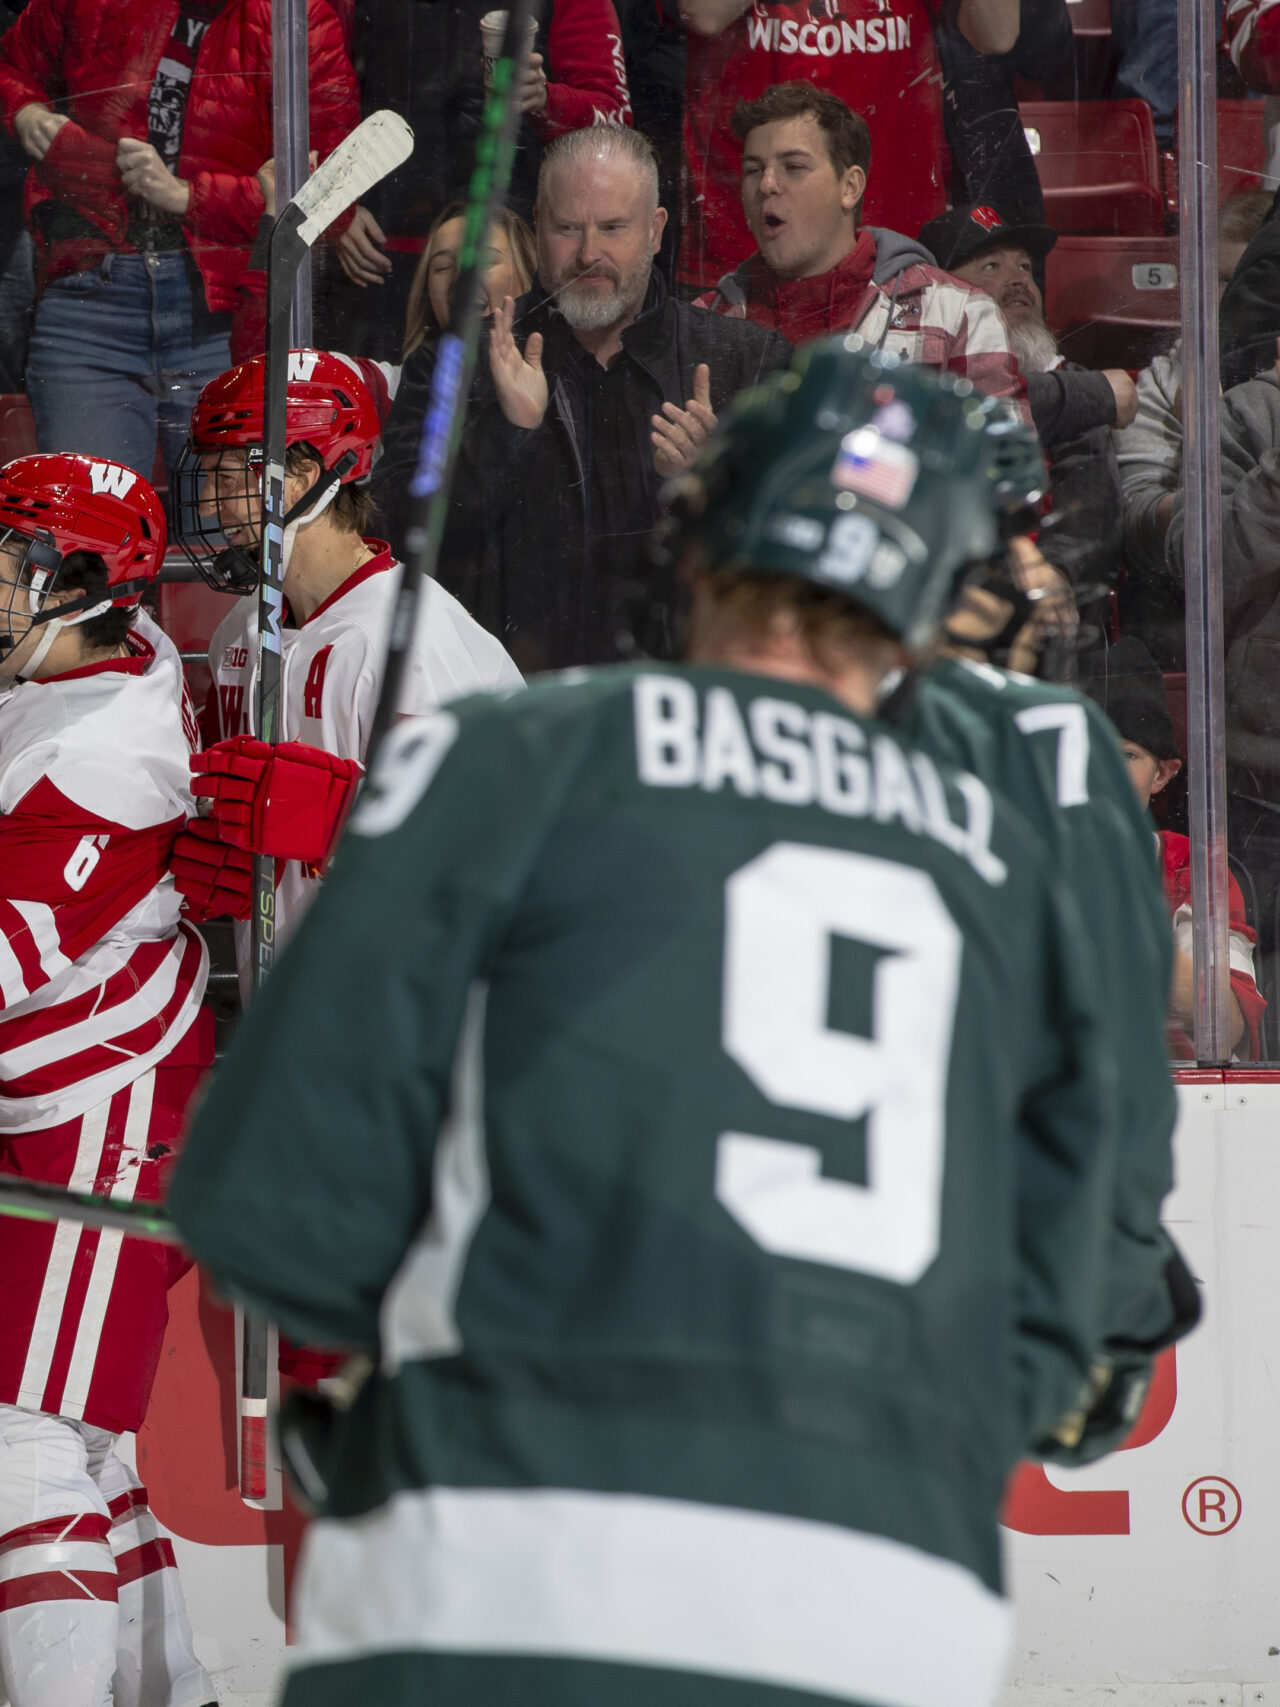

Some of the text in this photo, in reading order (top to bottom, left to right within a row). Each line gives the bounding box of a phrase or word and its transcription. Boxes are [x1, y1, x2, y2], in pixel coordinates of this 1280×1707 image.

[747, 15, 912, 57] WISCONSIN
[1148, 267, 1161, 286] 5
[89, 464, 137, 500] W
[304, 645, 335, 719] A
[1015, 703, 1091, 807] 7
[717, 841, 964, 1287] 9
